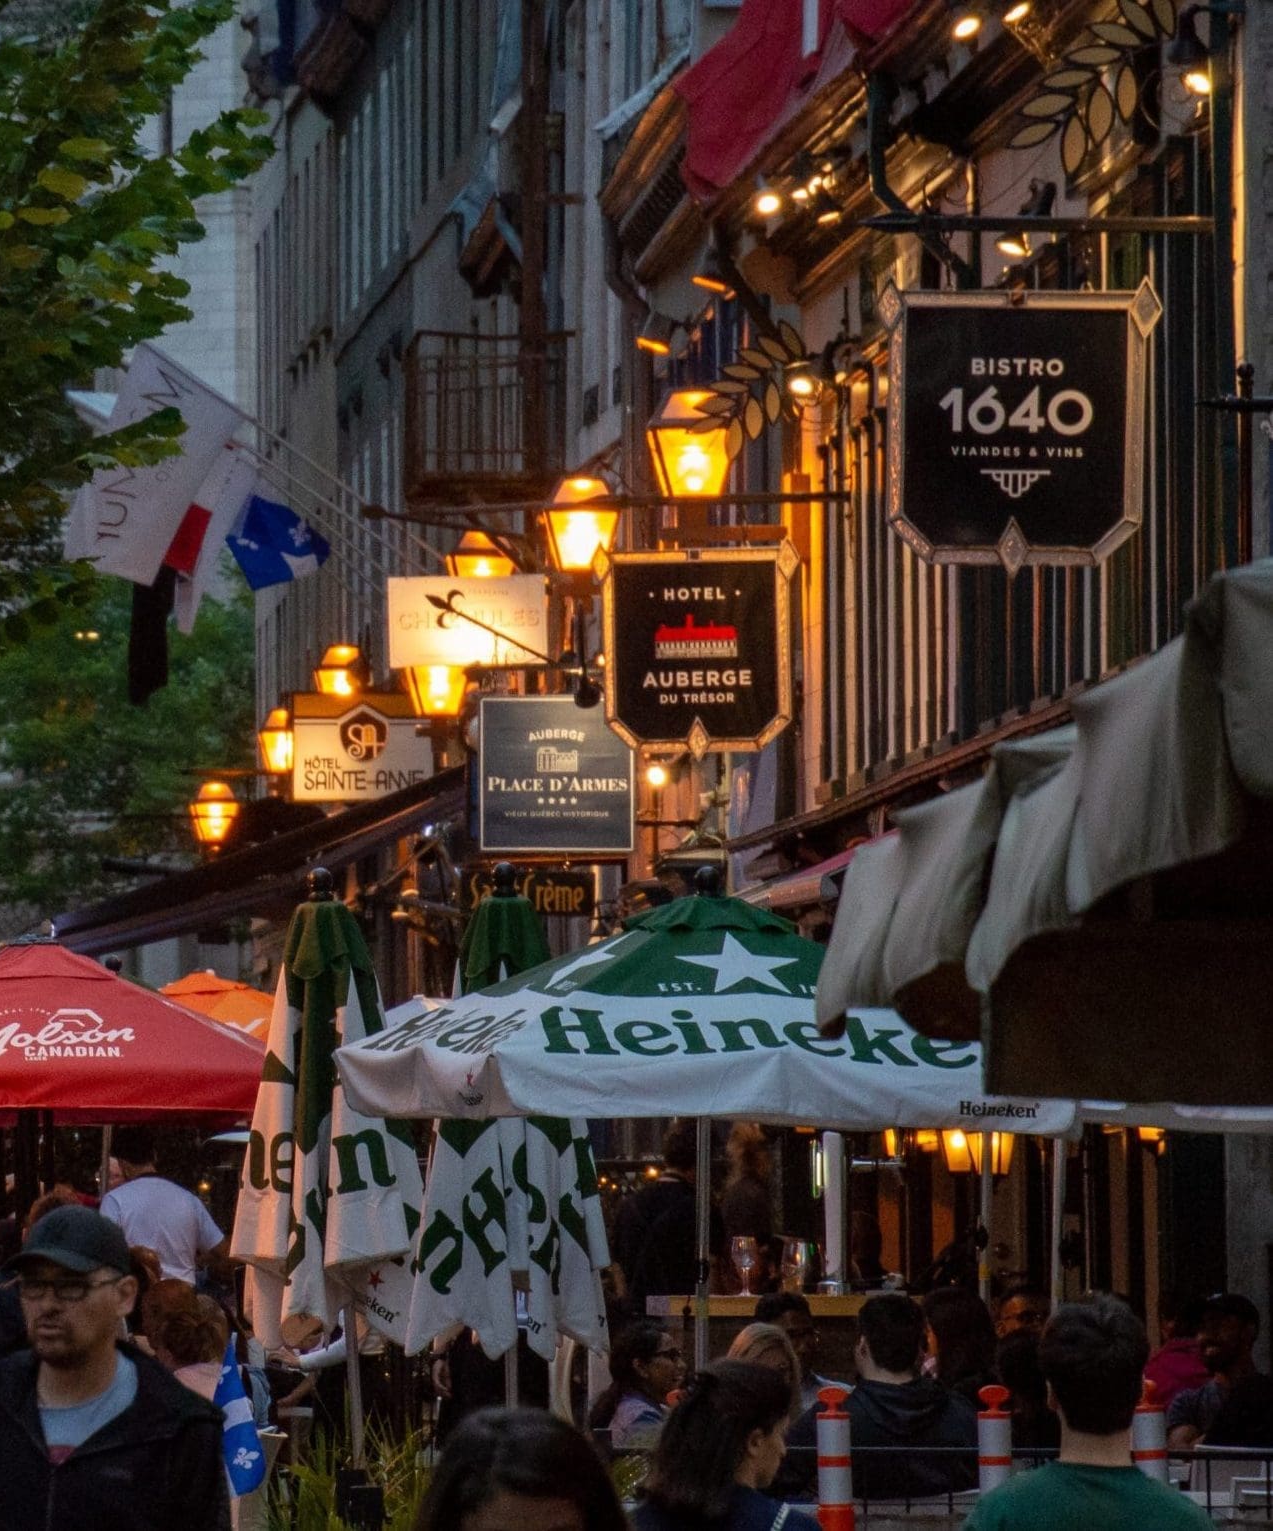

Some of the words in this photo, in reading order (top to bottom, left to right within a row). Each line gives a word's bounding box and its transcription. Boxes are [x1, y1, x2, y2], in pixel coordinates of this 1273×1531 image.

[971, 357, 1065, 377] BISTRO
[939, 384, 1094, 436] 1640
[951, 446, 1022, 457] VIANDES
[1029, 448, 1038, 457] &
[1046, 447, 1084, 458] VINS
[663, 586, 727, 601] HOTEL
[642, 669, 753, 689] AUBERGE
[659, 694, 678, 705] DU
[683, 691, 735, 704] TRÉSOR
[528, 728, 586, 743] AUBERGE
[304, 755, 341, 770] HÔTEL
[487, 775, 544, 792] PLACE
[657, 981, 702, 993] EST.
[539, 1005, 978, 1070] Heineke
[24, 1045, 121, 1058] CANADIAN
[959, 1100, 1038, 1119] Heineken
